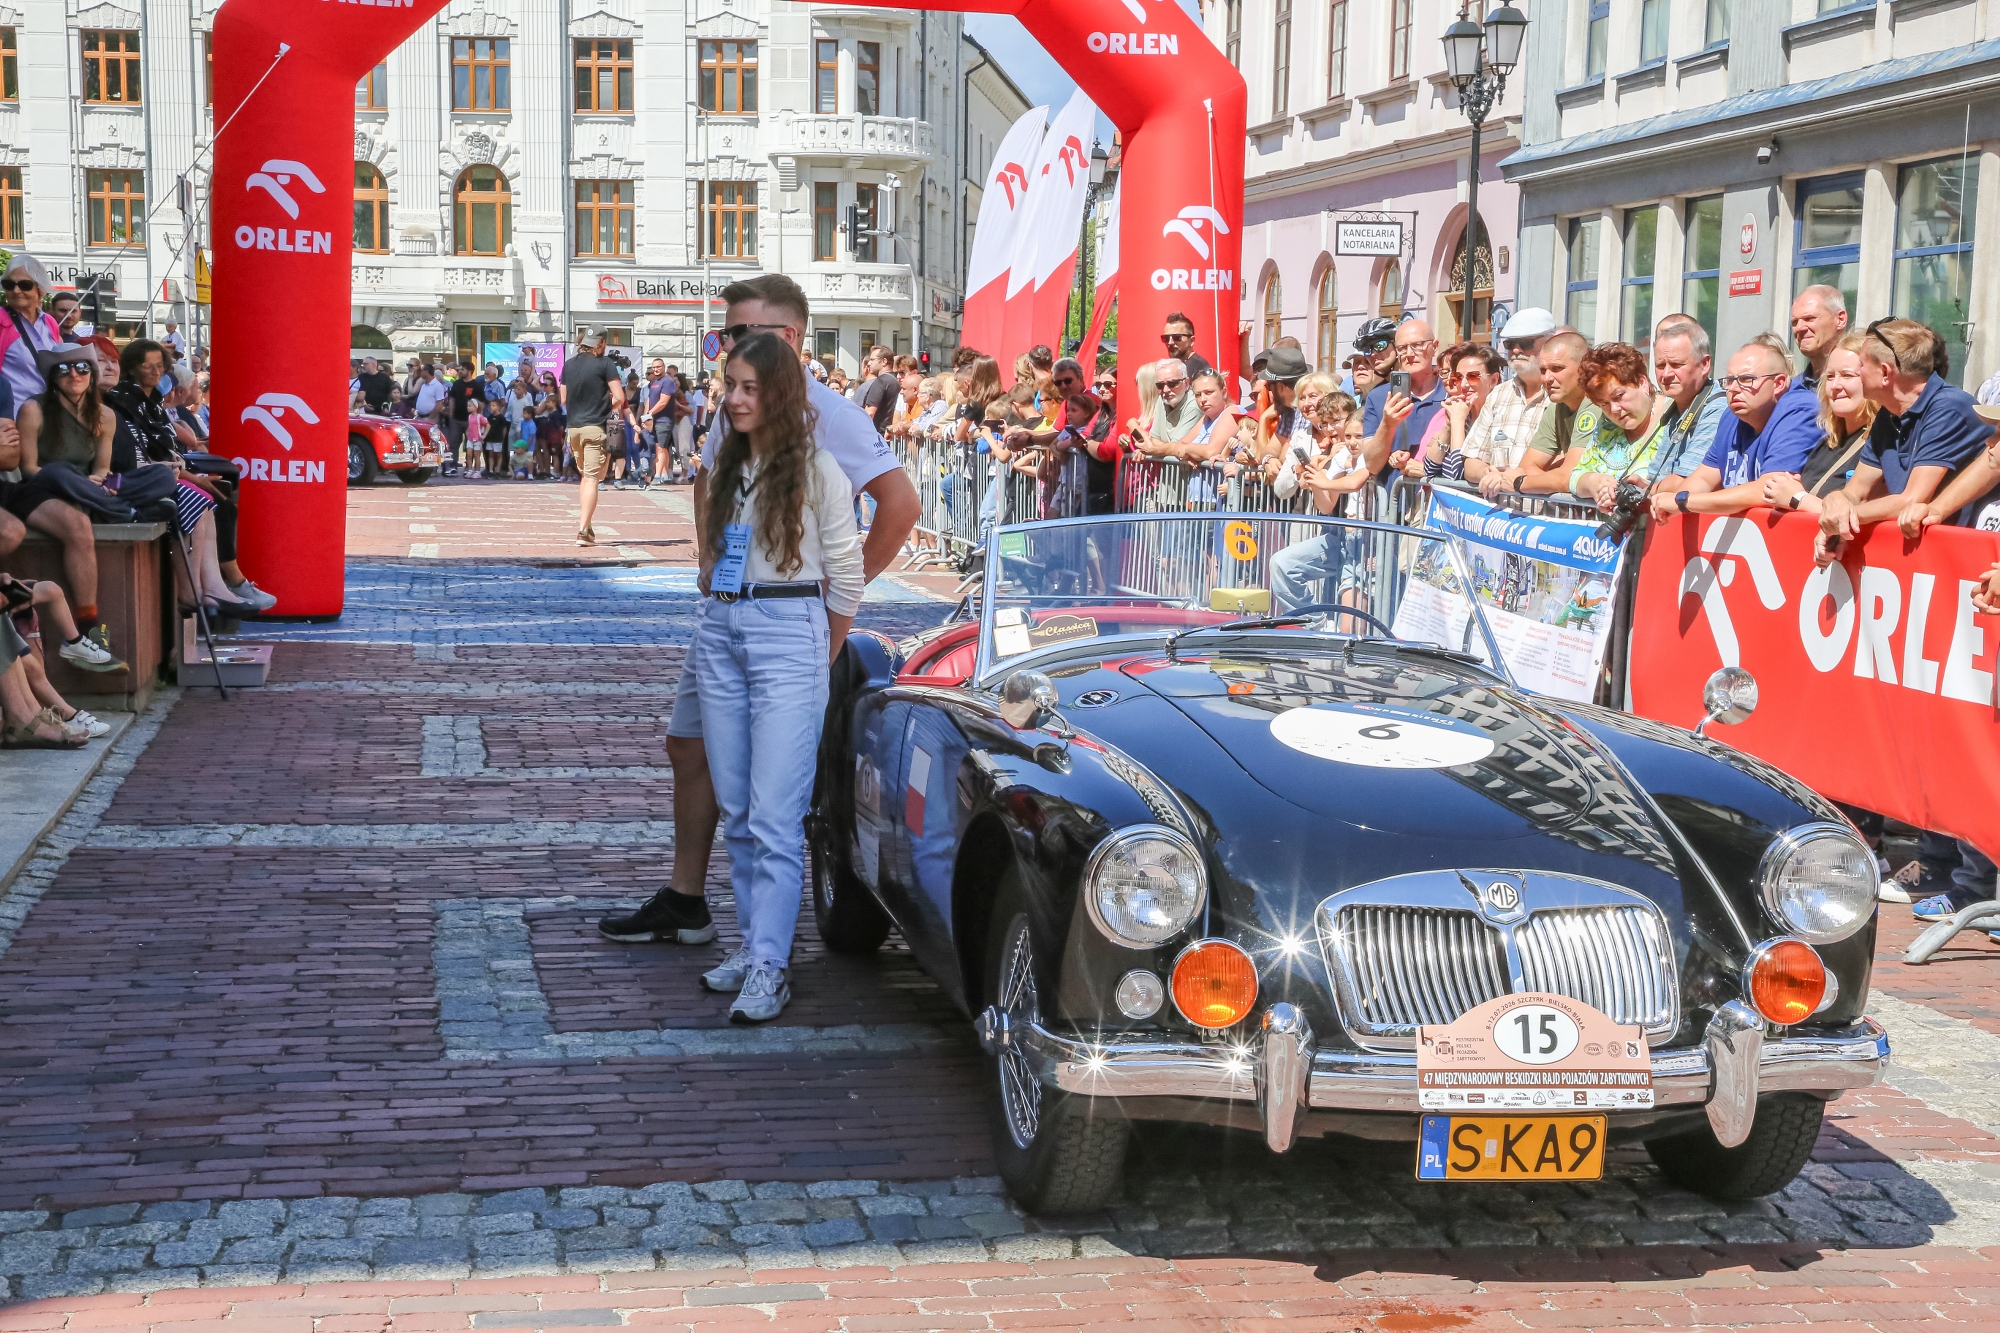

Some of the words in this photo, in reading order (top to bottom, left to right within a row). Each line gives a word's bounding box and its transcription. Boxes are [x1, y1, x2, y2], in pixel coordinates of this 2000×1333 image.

[1086, 31, 1179, 55] ORLEN
[234, 225, 332, 254] ORLEN
[1343, 228, 1396, 238] KANCELARIA
[1343, 240, 1395, 250] NOTARIALNA
[636, 279, 676, 296] Bank
[1150, 268, 1233, 291] ORLEN
[1681, 412, 1694, 430] Nikon
[230, 456, 326, 483] ORLEN
[1224, 520, 1258, 562] 6
[1484, 517, 1512, 541] AQUA
[1506, 522, 1528, 546] S.A.
[1572, 535, 1613, 560] AQUA
[1045, 622, 1092, 637] Classica
[1799, 559, 2000, 708] ORLE
[1358, 723, 1403, 740] 6
[1491, 884, 1516, 907] MG
[1486, 1001, 1516, 1031] 8-12.07.2026
[1517, 996, 1544, 1004] SZCZYRK
[1548, 998, 1586, 1031] BIELSKO-BIAŁA
[1513, 1014, 1559, 1055] 15
[1423, 1072, 1434, 1085] 47
[1434, 1072, 1504, 1088] MIĘDZYNARODOWY
[1505, 1072, 1541, 1085] BESKIDZKI
[1542, 1072, 1561, 1085] RAJD
[1561, 1070, 1599, 1085] POJAZDÓW
[1600, 1072, 1649, 1085] ZABYTKOWYCH
[1451, 1123, 1483, 1173] S
[1425, 1154, 1442, 1168] PL
